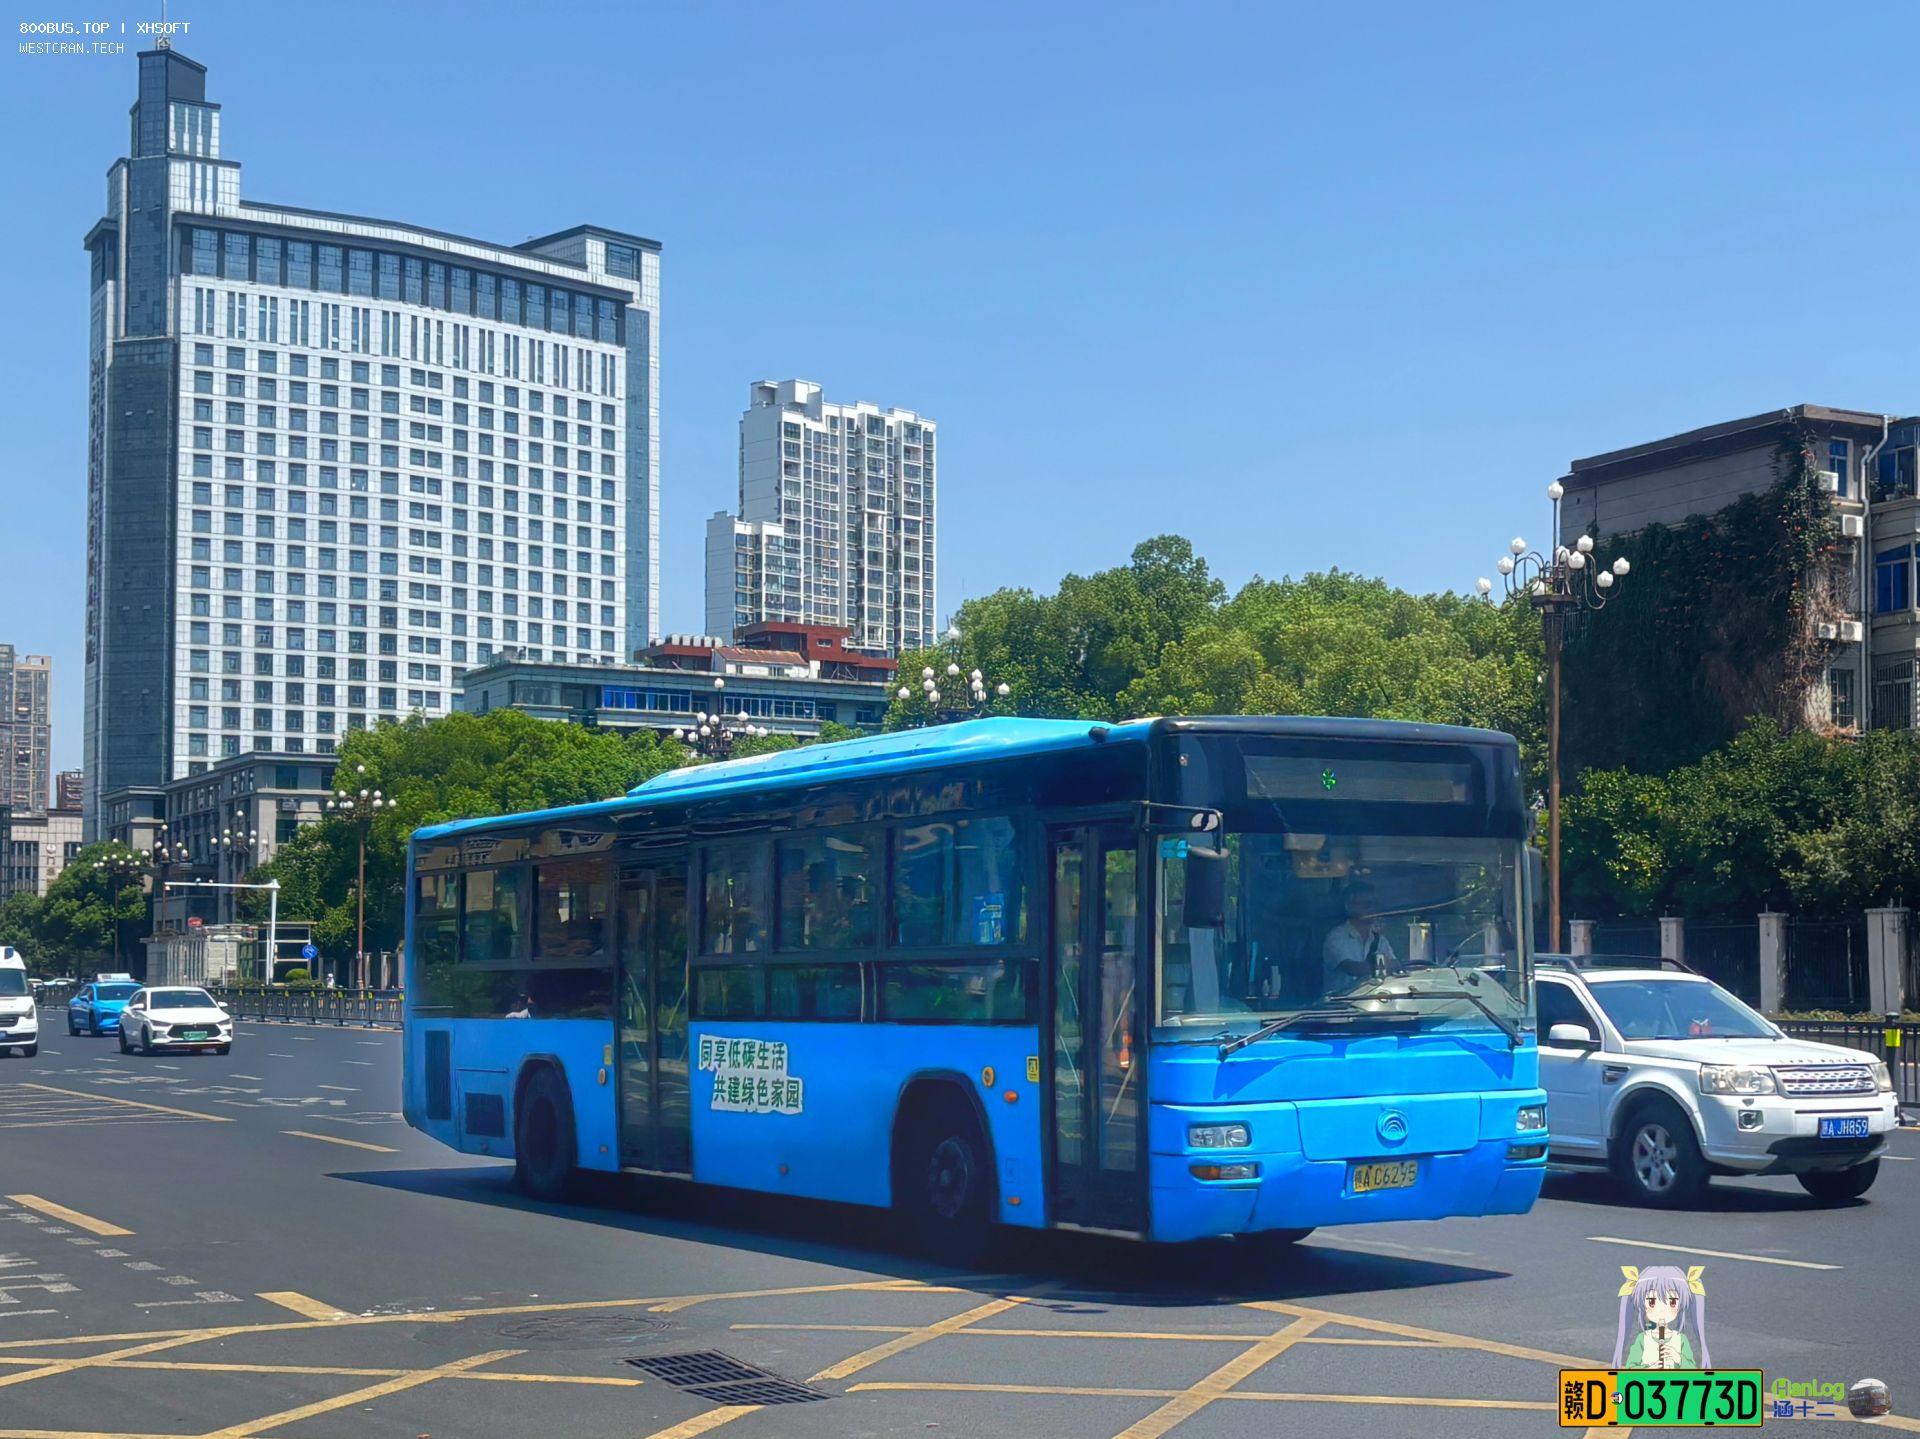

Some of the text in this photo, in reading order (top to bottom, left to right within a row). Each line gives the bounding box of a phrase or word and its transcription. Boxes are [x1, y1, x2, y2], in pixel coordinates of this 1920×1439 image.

[701, 1039, 786, 1071] 同享低碳生活
[713, 1074, 800, 1108] 共建绿色家园
